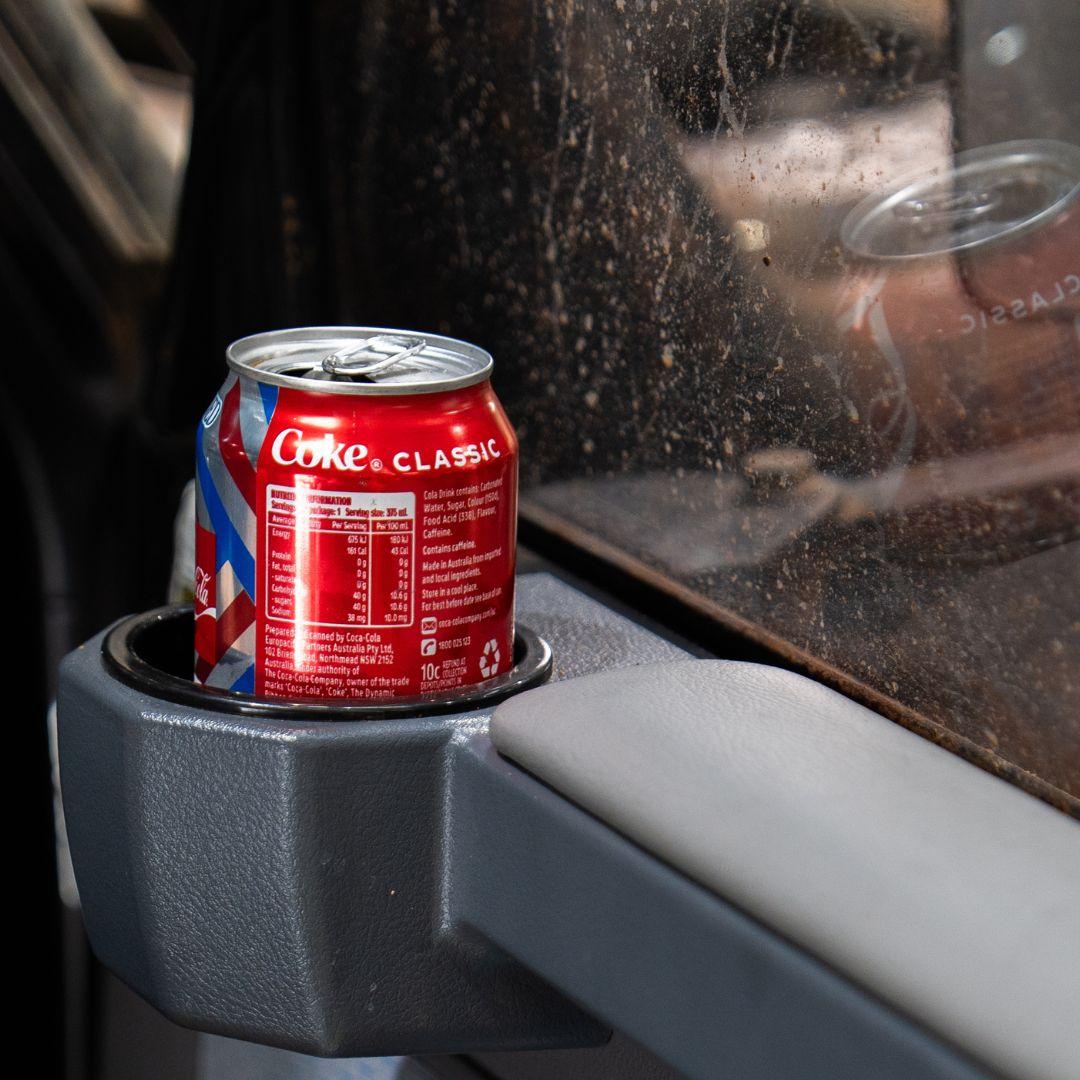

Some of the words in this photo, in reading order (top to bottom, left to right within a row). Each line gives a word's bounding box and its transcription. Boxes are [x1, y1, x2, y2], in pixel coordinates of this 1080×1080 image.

[271, 428, 368, 471] Coke
[393, 438, 501, 472] CLASSIC
[271, 489, 296, 501] NUTRITI
[307, 494, 352, 505] NFORMATION
[424, 489, 438, 500] Cola
[439, 488, 455, 498] Drink
[309, 505, 336, 516] ackage:
[345, 507, 369, 518] Serving
[424, 503, 446, 513] Water,
[331, 521, 342, 529] Per
[344, 521, 367, 531] Serving
[376, 522, 386, 530] Per
[423, 516, 441, 526] Food
[443, 513, 457, 523] Acid
[272, 528, 290, 539] Energy
[423, 528, 453, 539] Caffeine.
[423, 544, 451, 555] Contains
[422, 560, 439, 571] Made
[441, 559, 447, 569] in
[448, 556, 472, 568] Australia
[422, 573, 435, 584] and
[436, 572, 450, 582] local
[422, 589, 439, 599] Store
[451, 584, 463, 594] cool
[422, 602, 432, 611] For
[432, 600, 445, 610] best
[336, 632, 345, 643] by
[346, 632, 381, 642] Coca-Cola
[333, 643, 365, 653] Australia
[367, 644, 379, 655] Pty
[277, 648, 295, 658] Brien
[320, 654, 359, 664] Northmead
[360, 655, 376, 664] NSW
[378, 655, 393, 664] 2152
[318, 664, 350, 677] authority
[352, 665, 360, 675] of
[421, 662, 440, 680] 10c
[265, 668, 276, 678] The
[277, 670, 309, 683] Coca-Cola
[310, 675, 344, 687] Company,
[346, 678, 369, 686] owner
[370, 677, 377, 686] of
[379, 677, 390, 686] the
[391, 677, 410, 686] trade
[265, 681, 283, 690] marks
[351, 688, 363, 697] The
[365, 688, 395, 699] Dynamic
